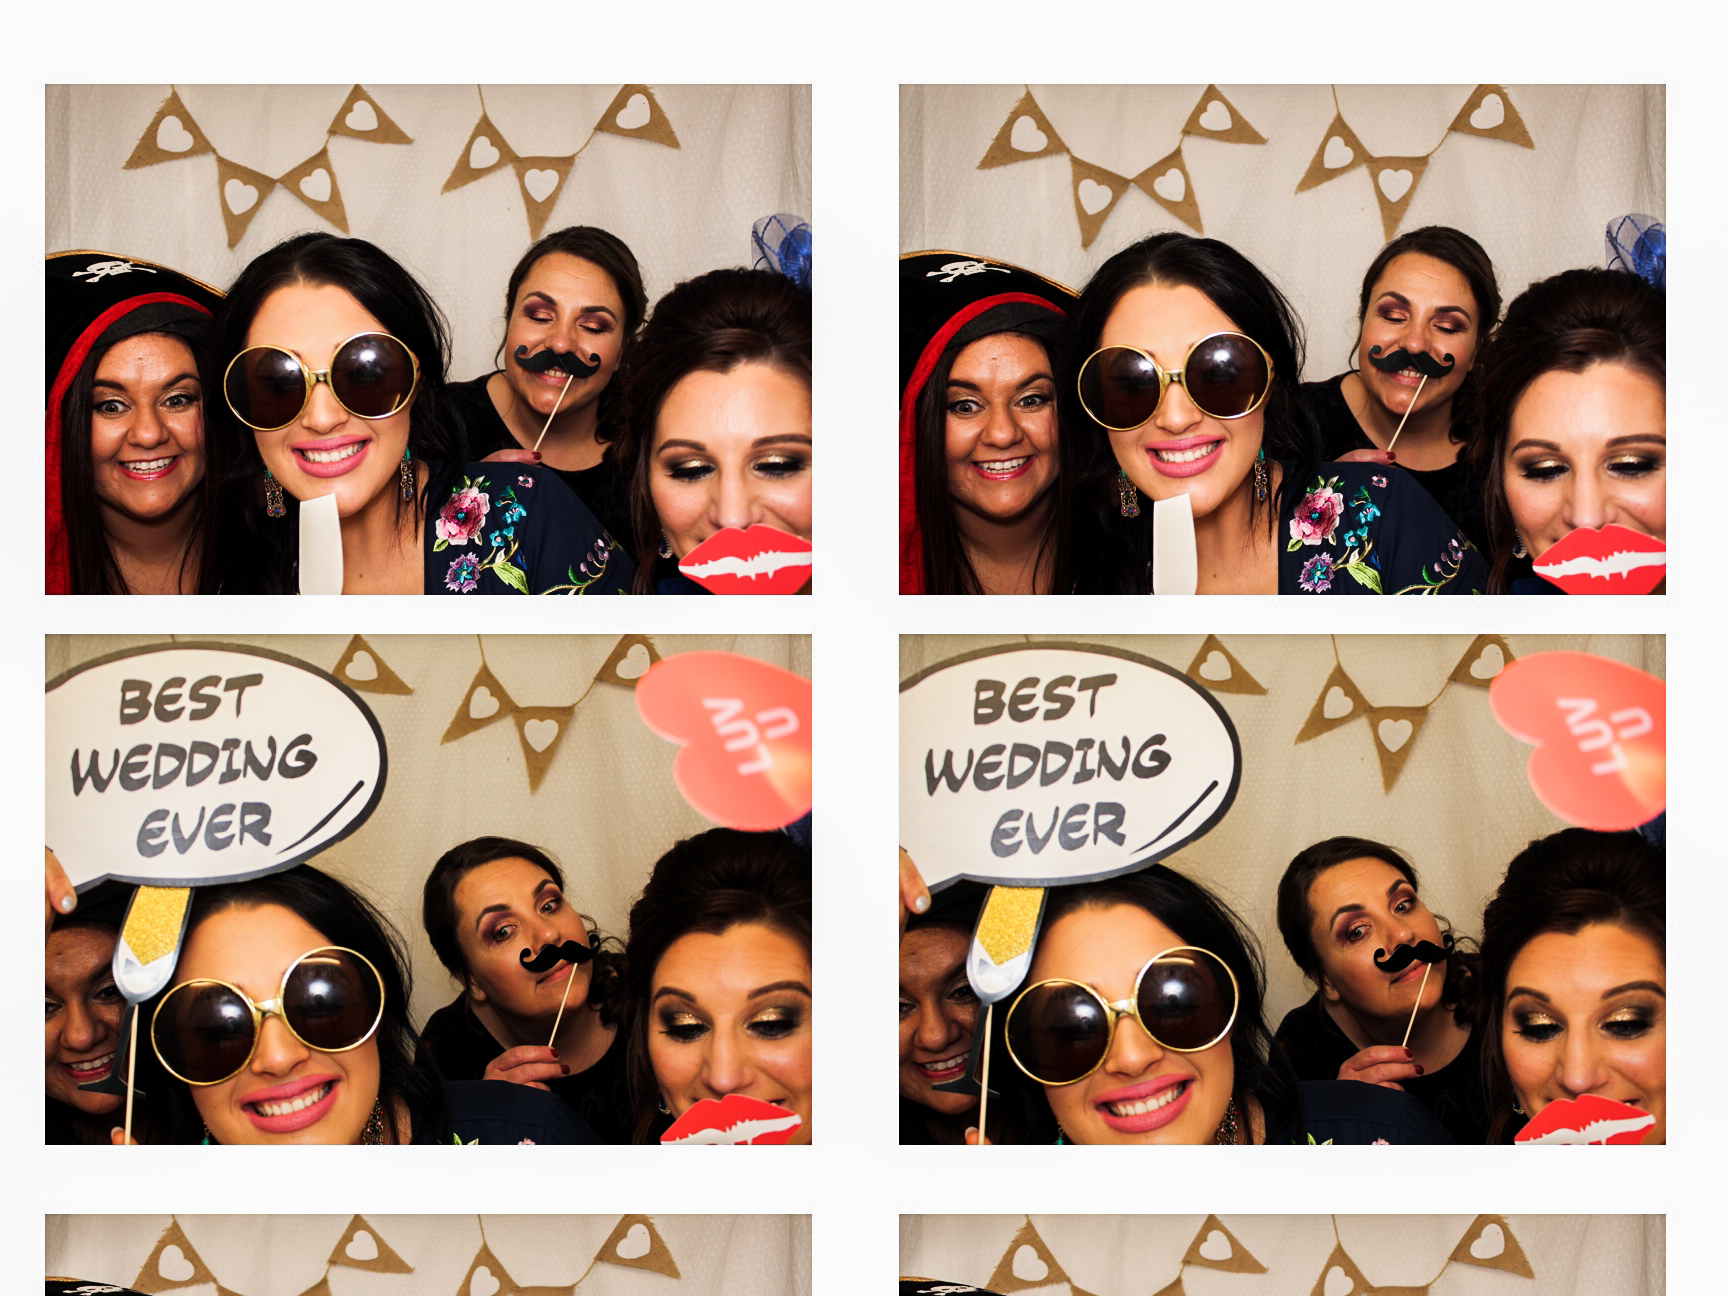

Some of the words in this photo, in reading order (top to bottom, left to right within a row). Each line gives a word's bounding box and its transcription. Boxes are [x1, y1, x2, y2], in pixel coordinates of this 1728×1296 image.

[120, 674, 263, 725] BEST
[974, 674, 1117, 725] BEST
[71, 734, 317, 796] WEDDING
[925, 734, 1171, 796] WEDDING
[137, 802, 272, 857] EVER
[991, 802, 1126, 857] EVER
